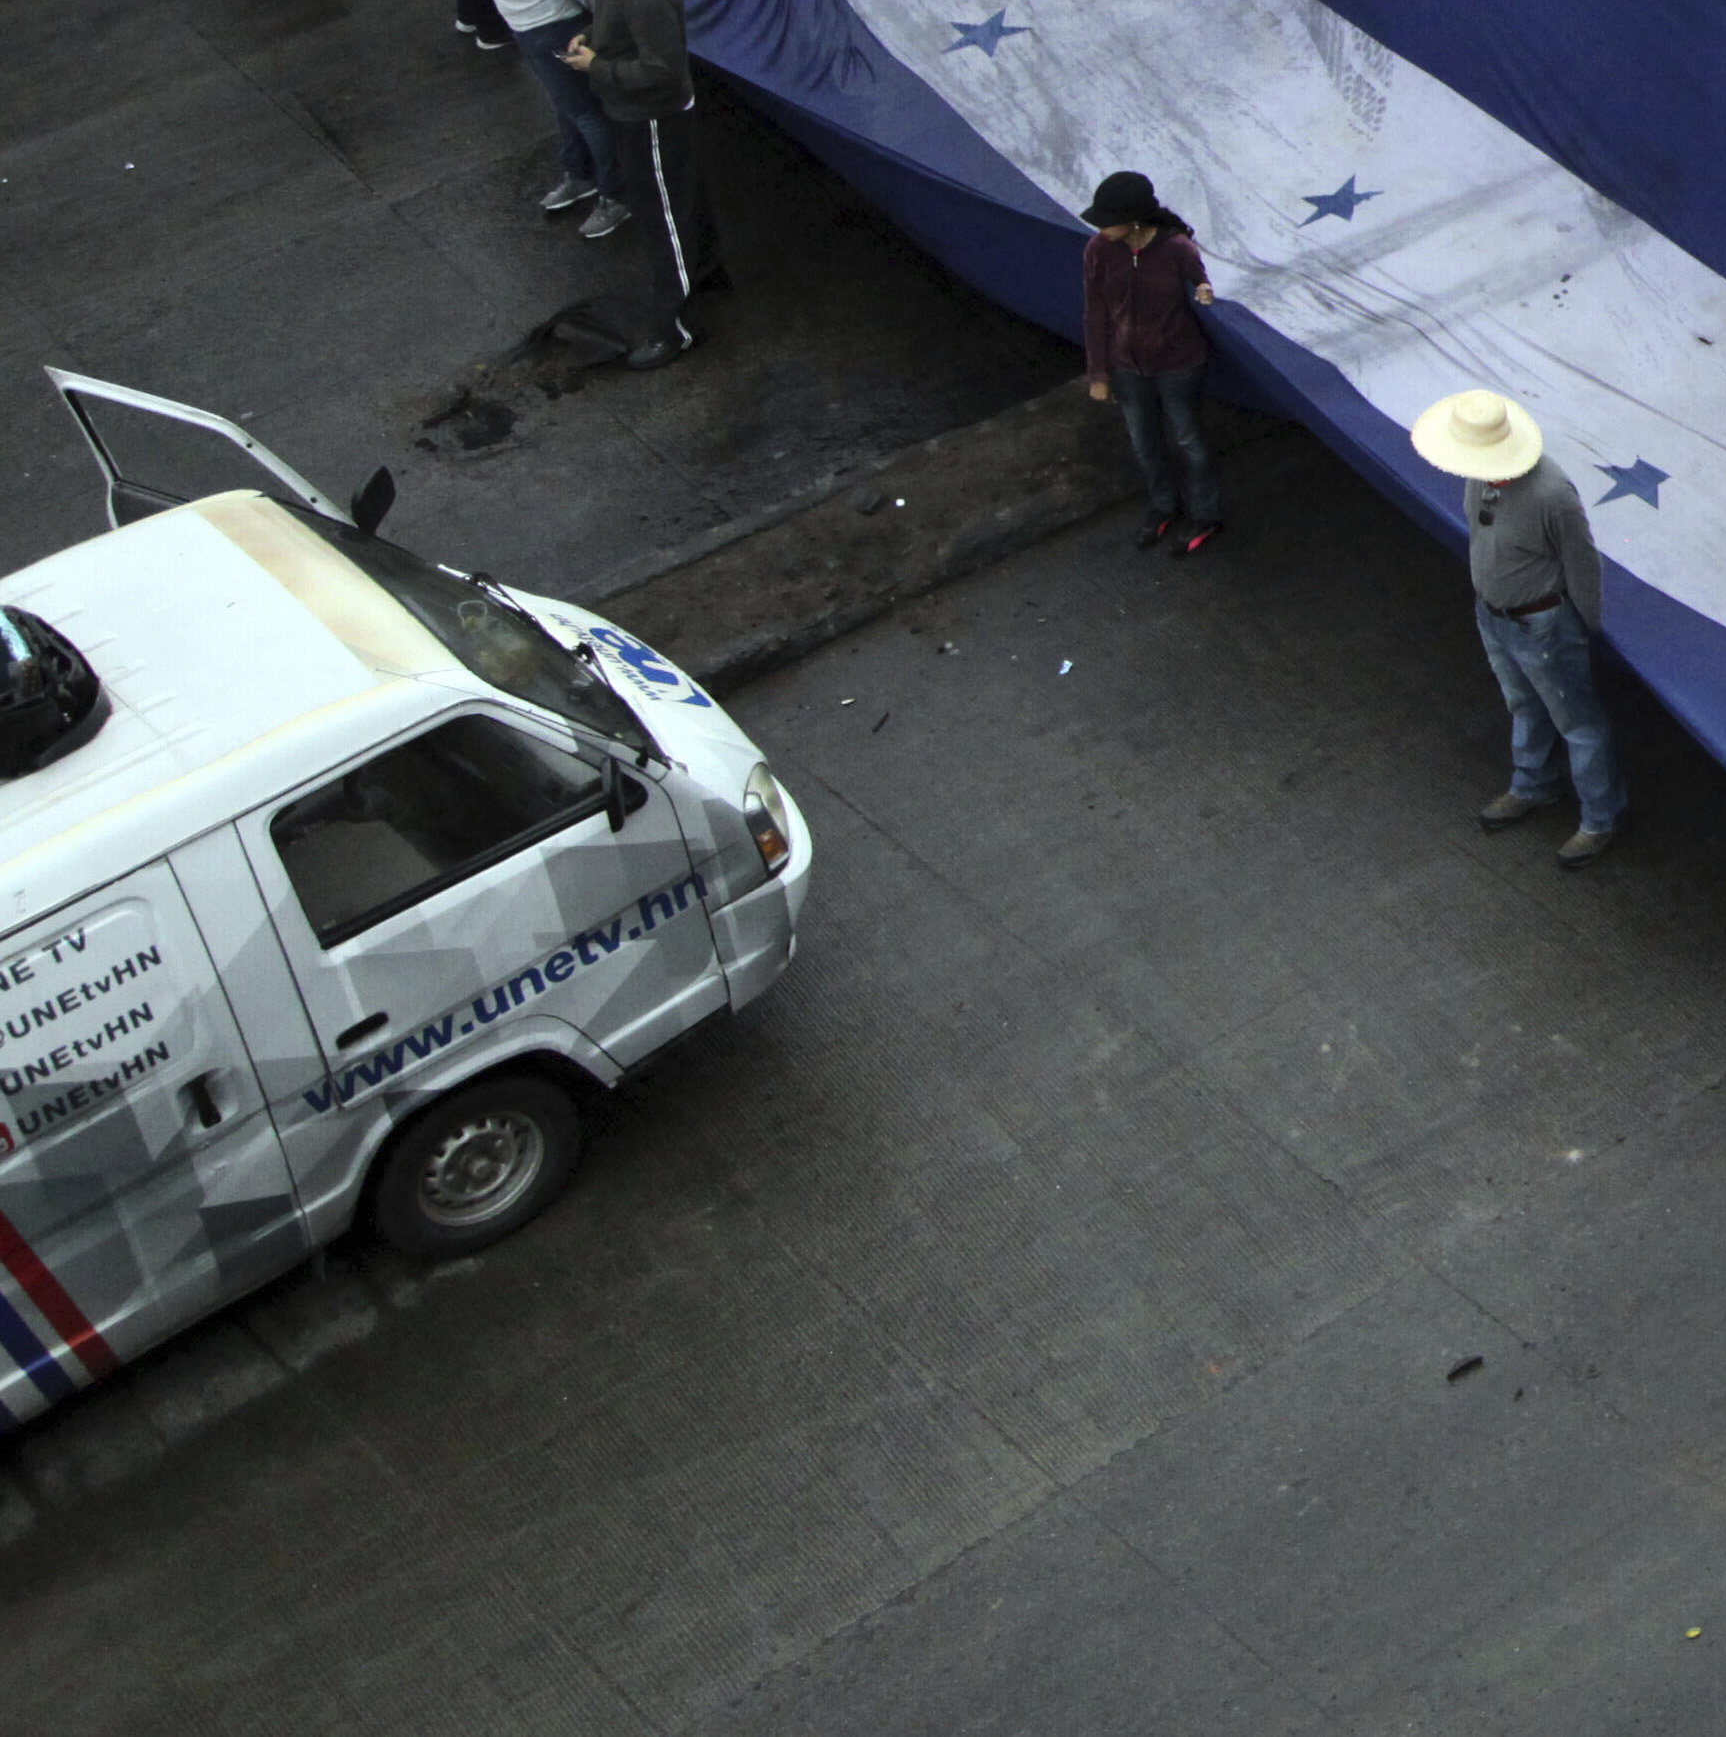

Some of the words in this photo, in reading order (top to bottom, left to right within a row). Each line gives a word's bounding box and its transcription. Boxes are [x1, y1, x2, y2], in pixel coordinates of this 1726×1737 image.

[42, 927, 87, 963] TV
[303, 872, 708, 1113] www.unetv.hn
[0, 944, 162, 1048] UNEtvHN
[16, 1041, 170, 1135] UNEtvHN
